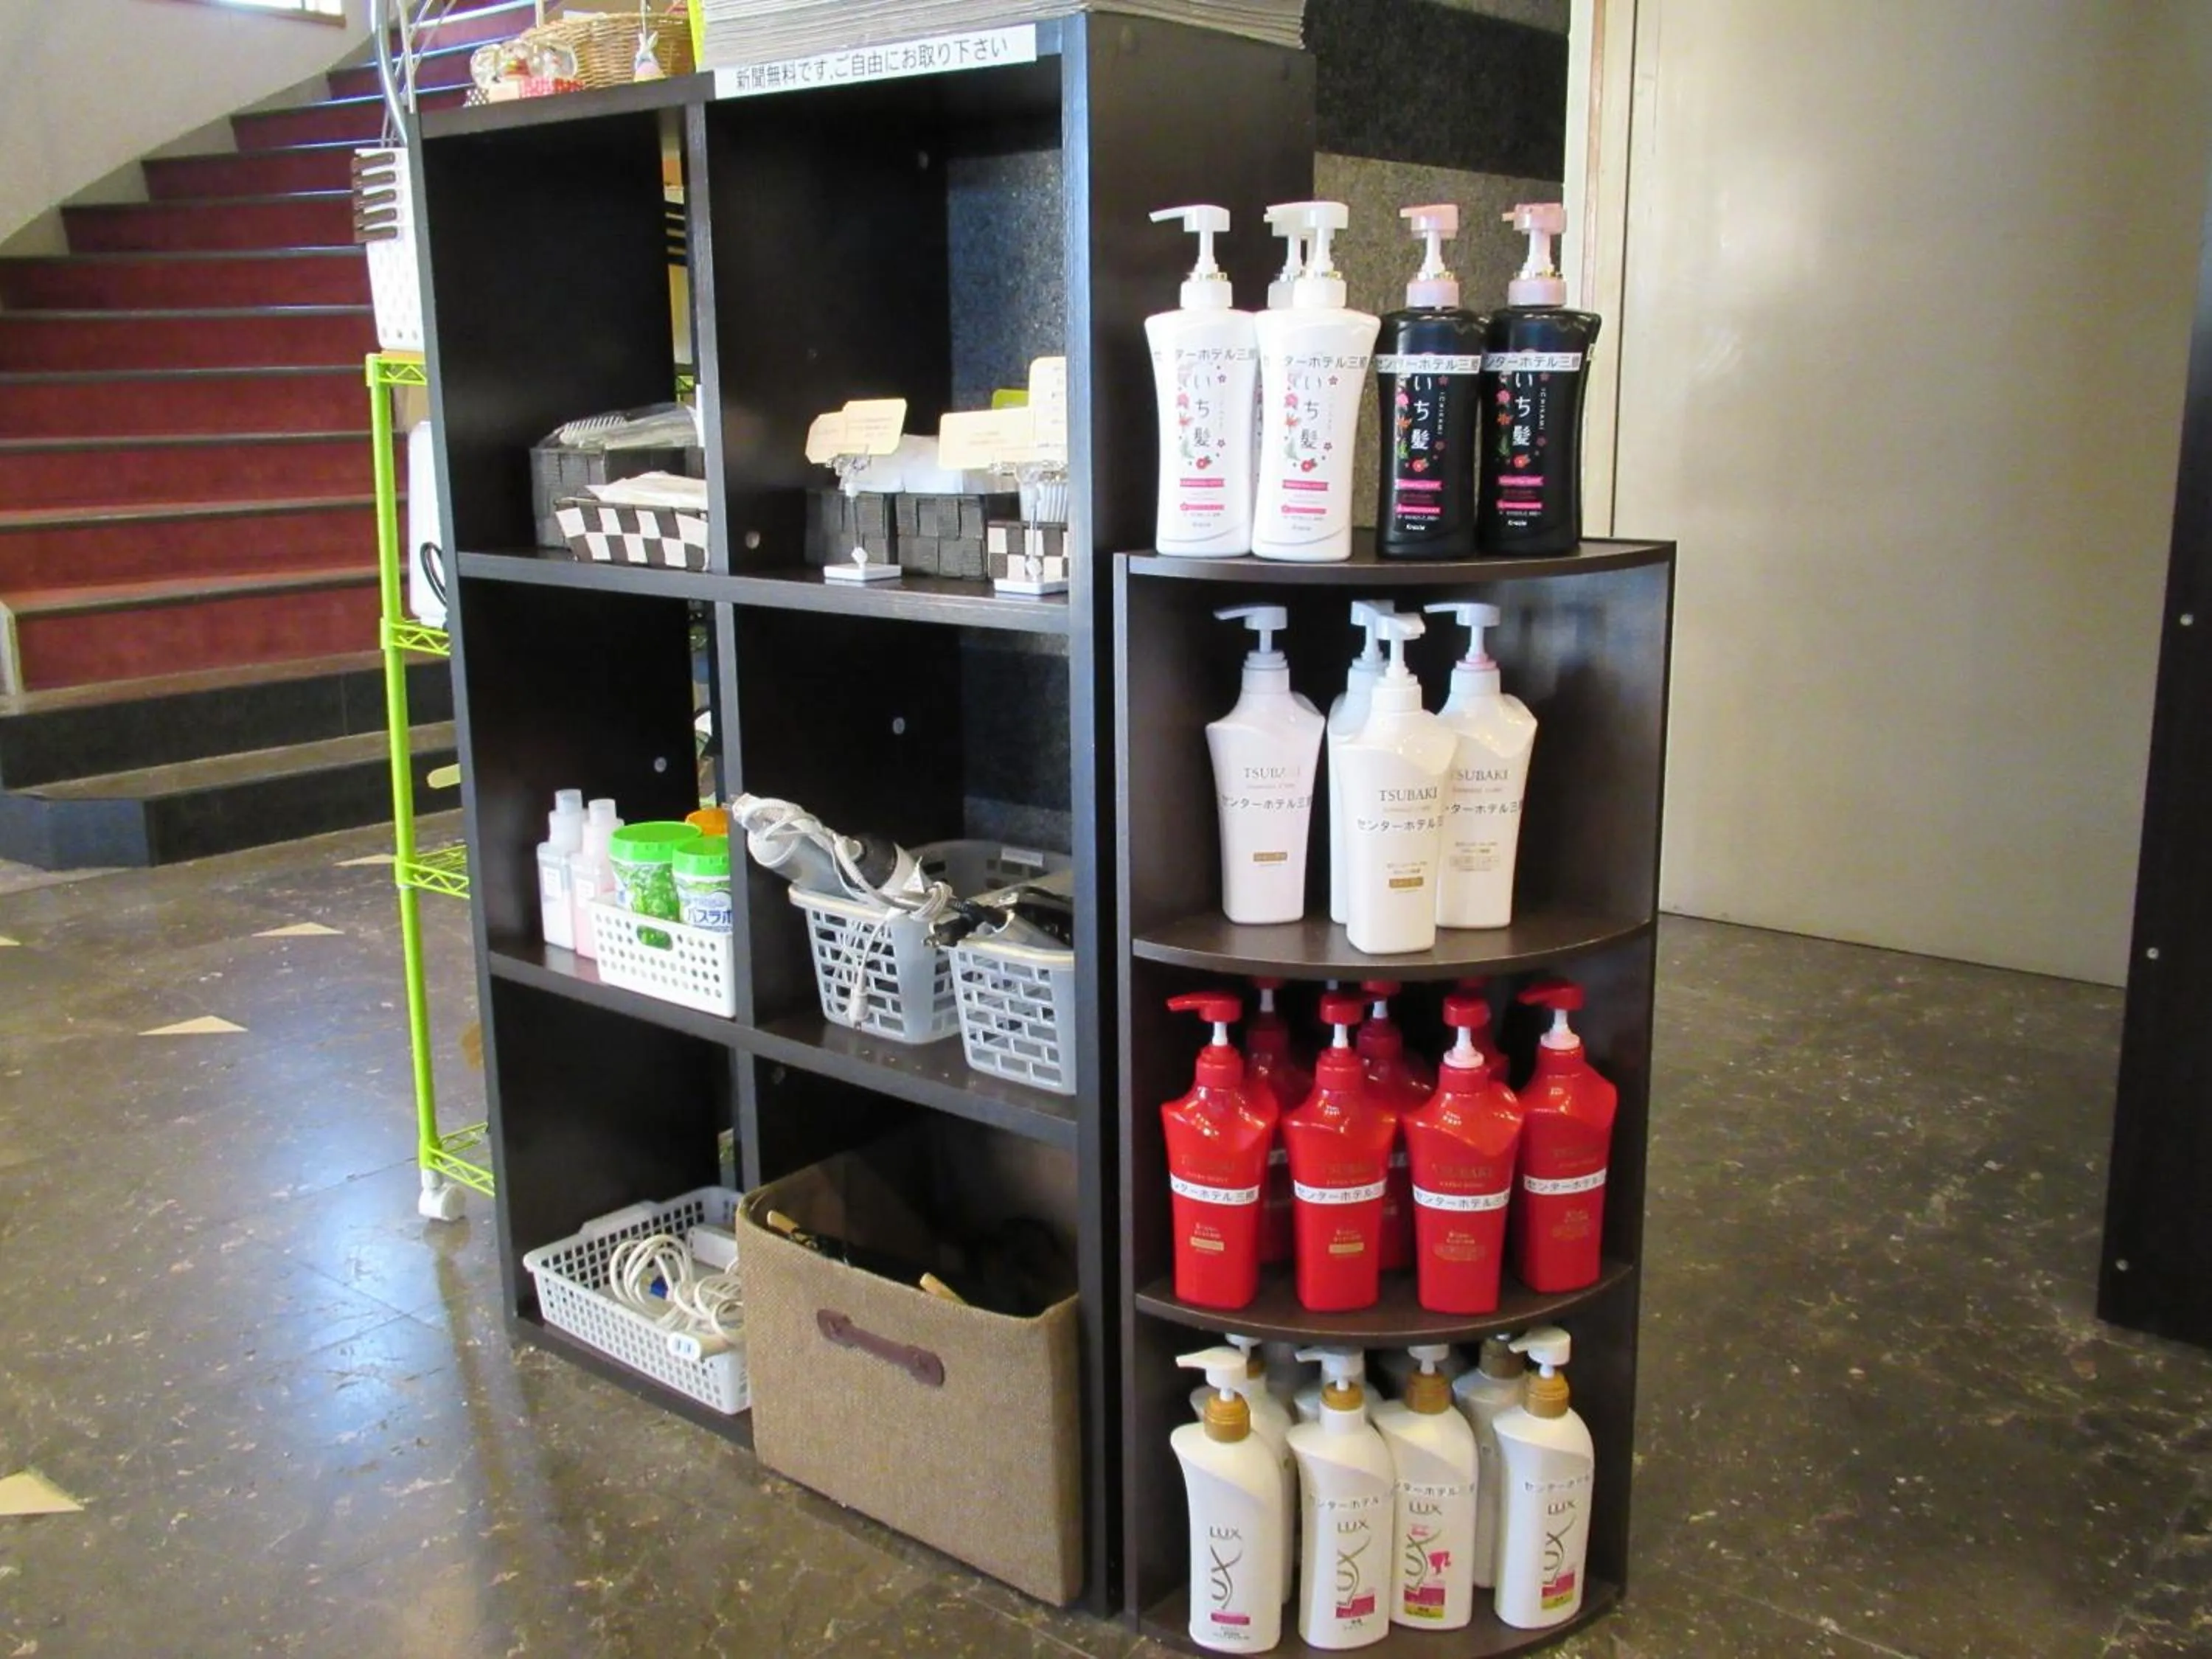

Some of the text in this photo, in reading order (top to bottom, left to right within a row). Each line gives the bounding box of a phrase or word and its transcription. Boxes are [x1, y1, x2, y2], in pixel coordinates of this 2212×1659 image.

[1411, 375, 1431, 450] いち髪
[1512, 372, 1532, 446] いち髪
[1244, 767, 1301, 779] TSUBI
[1380, 786, 1437, 801] TSUBAKI
[1410, 1501, 1442, 1515] LUX
[1210, 1526, 1242, 1540] LUX
[1338, 1520, 1369, 1533] LUX
